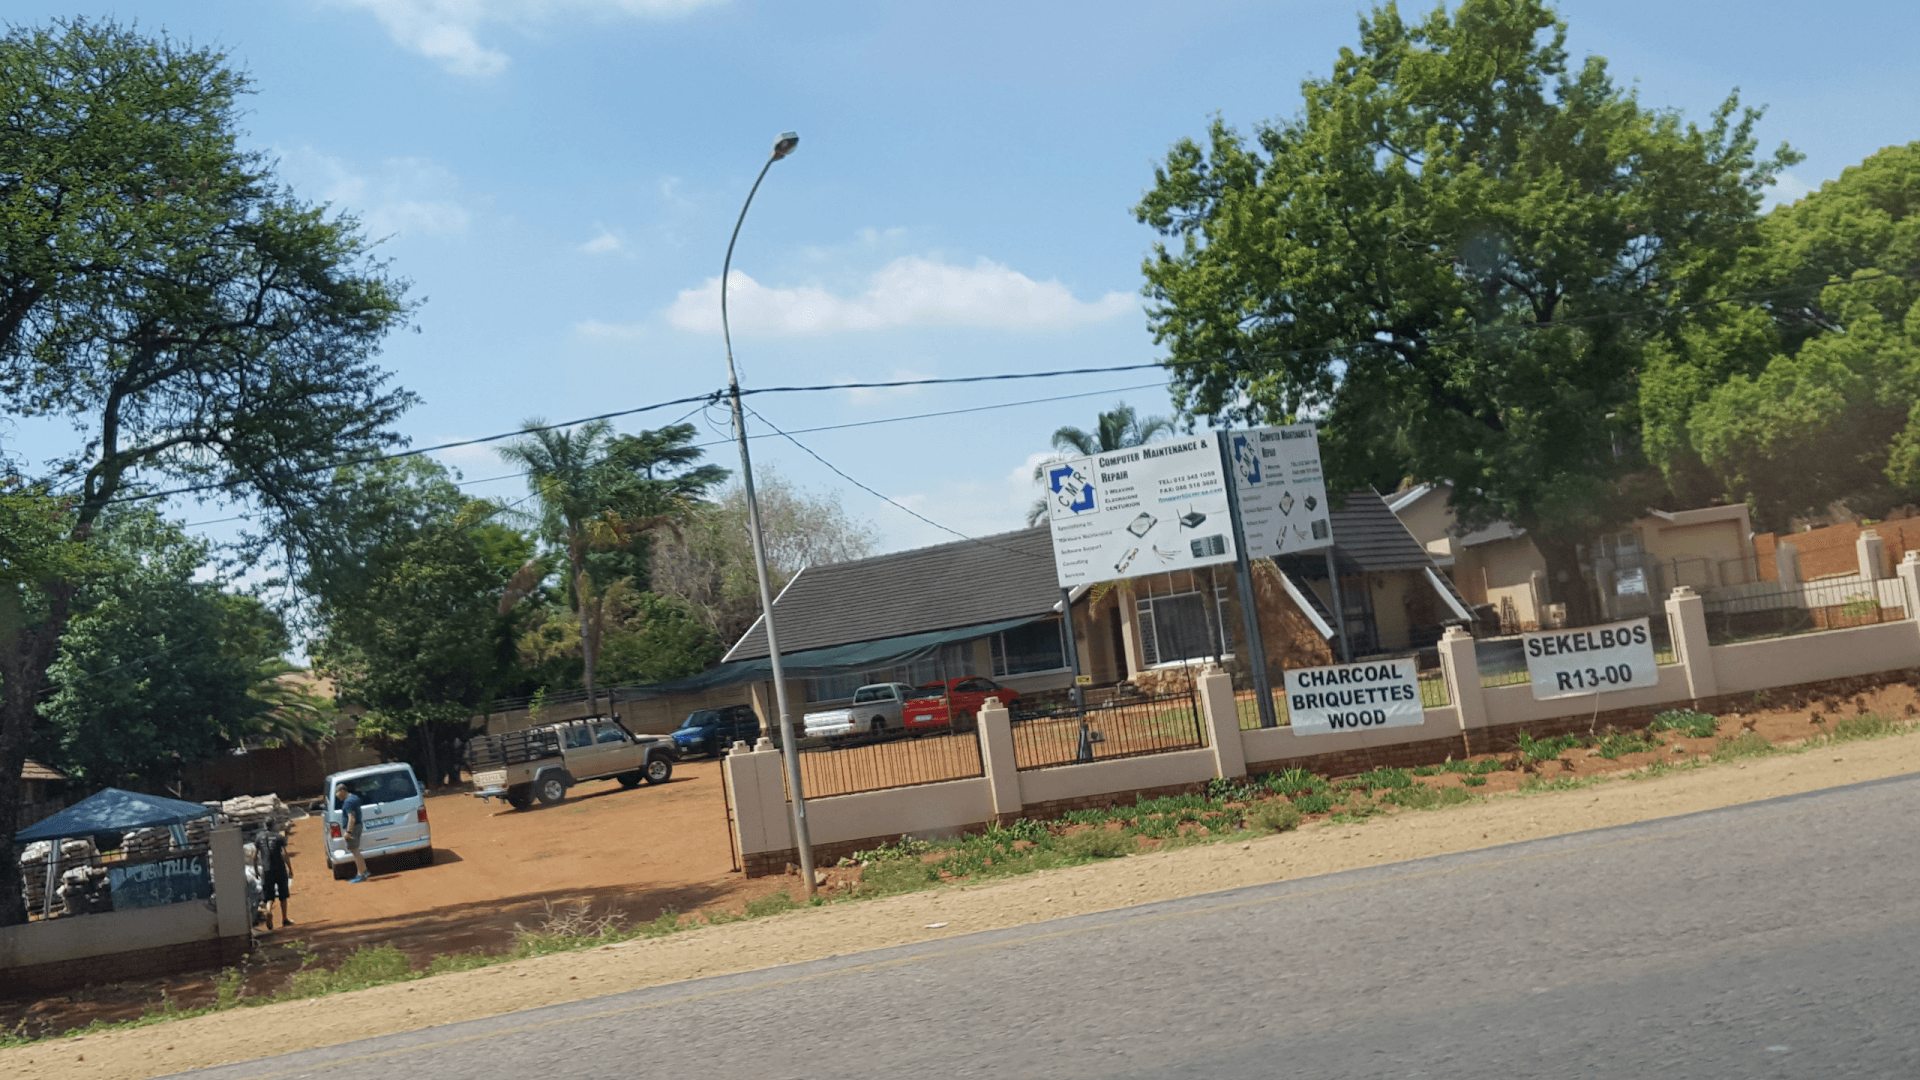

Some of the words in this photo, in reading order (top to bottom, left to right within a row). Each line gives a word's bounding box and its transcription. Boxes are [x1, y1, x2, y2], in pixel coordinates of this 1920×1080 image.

[1098, 452, 1140, 468] COMPUTER
[1142, 441, 1197, 460] MAINTENANCE
[1201, 439, 1208, 449] &
[1058, 470, 1087, 508] CMR
[1101, 470, 1129, 484] REPAIR
[1528, 625, 1647, 658] SEKELBOS
[1297, 663, 1403, 688] CHARCOAL
[1556, 663, 1633, 691] R13-00
[1292, 683, 1415, 711] BRIQUETTES
[1328, 708, 1386, 730] WOOD
